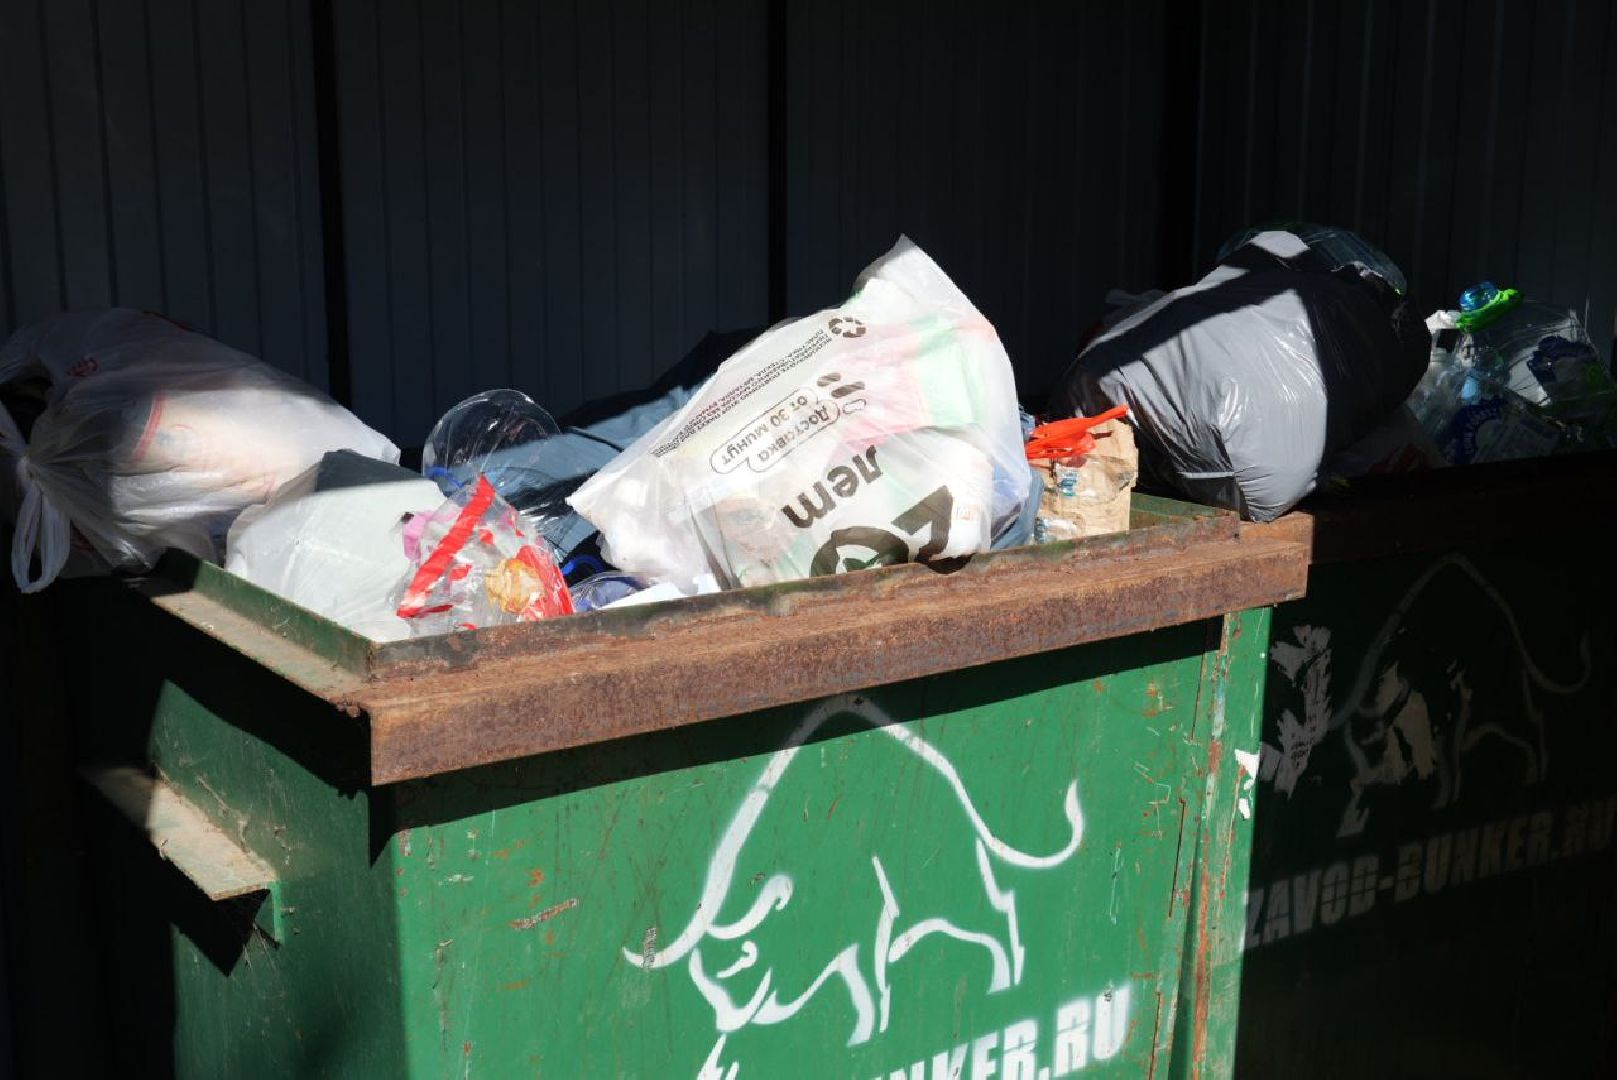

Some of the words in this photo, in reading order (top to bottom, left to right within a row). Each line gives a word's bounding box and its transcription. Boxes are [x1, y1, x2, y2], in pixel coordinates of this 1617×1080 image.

[769, 408, 791, 427] 30
[790, 395, 808, 411] от
[756, 404, 830, 463] Доставка
[782, 445, 883, 528] лет
